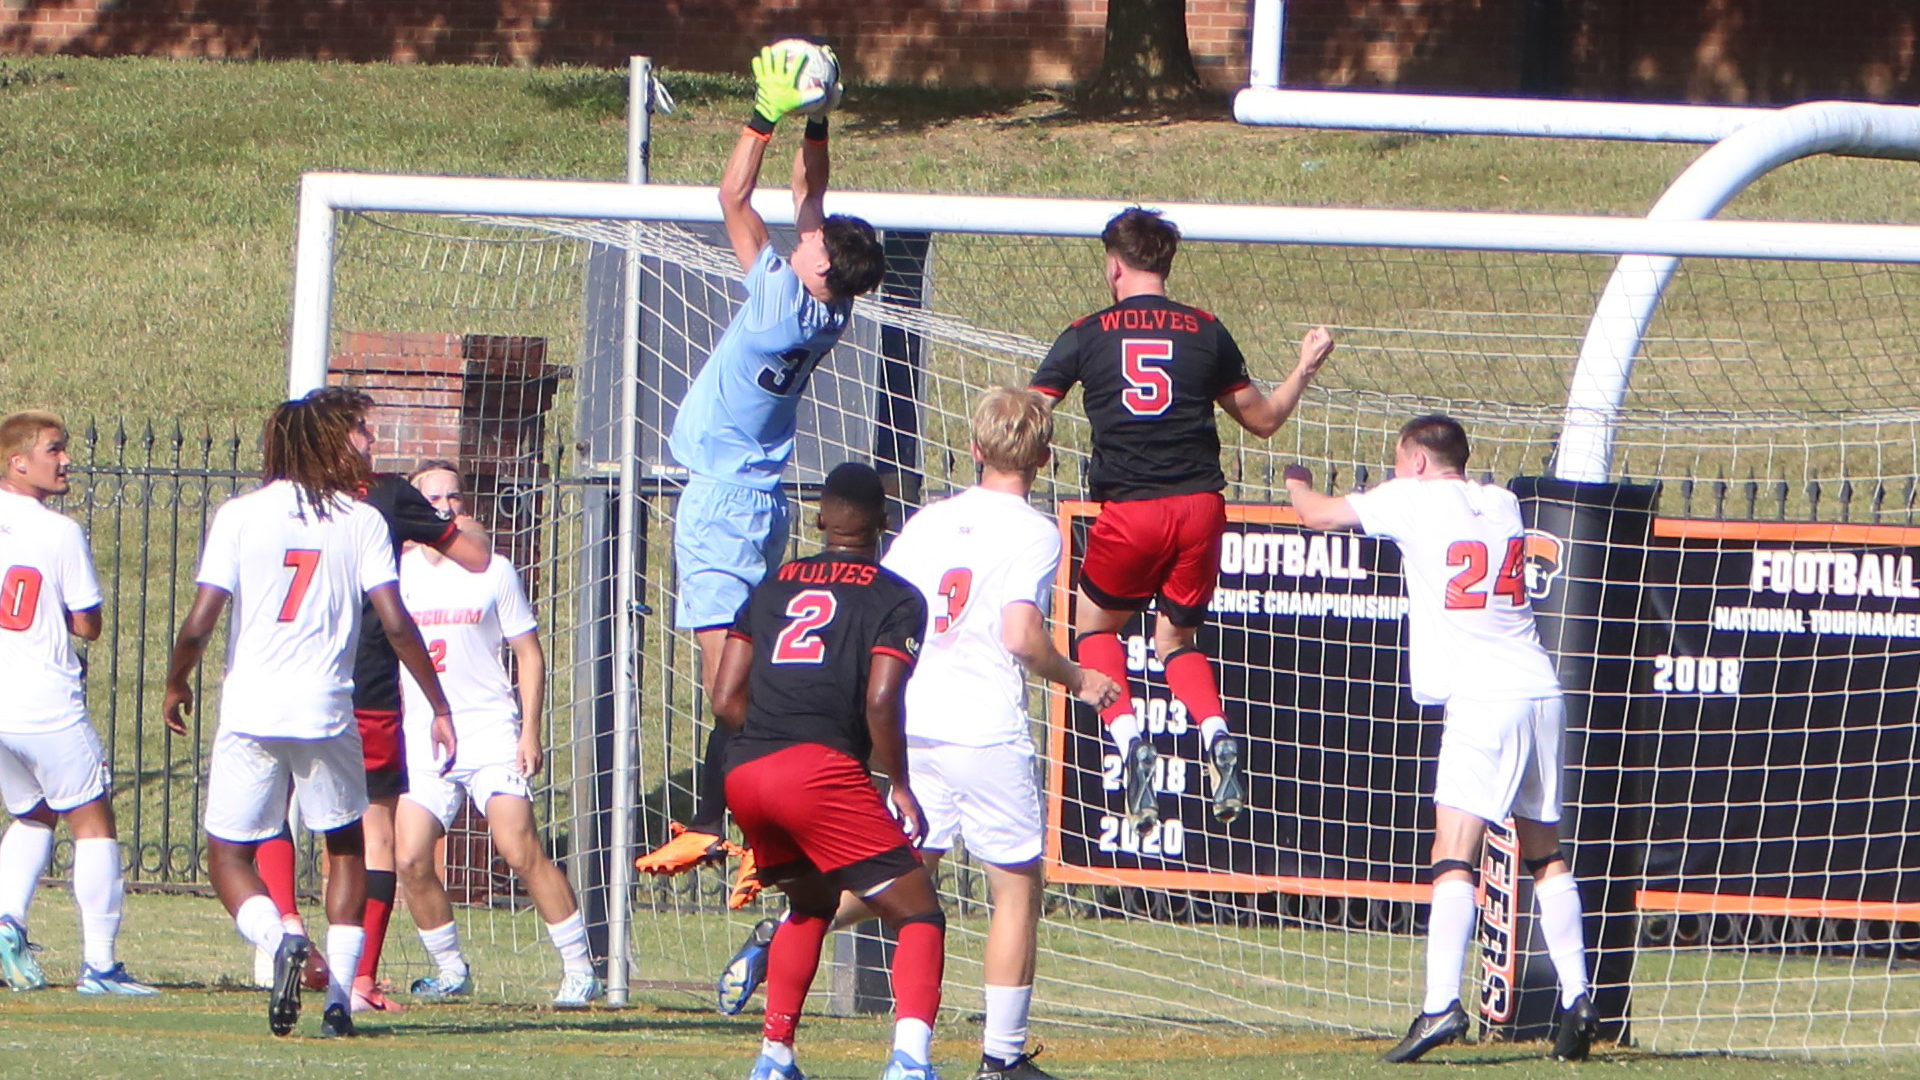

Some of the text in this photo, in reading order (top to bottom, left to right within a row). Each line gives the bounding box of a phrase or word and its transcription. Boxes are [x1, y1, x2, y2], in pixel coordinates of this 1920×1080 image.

[1100, 309, 1199, 332] WOLVES
[1122, 338, 1173, 416] 5
[778, 561, 878, 585] WOLVES
[1220, 531, 1368, 580] OOTBALL
[1445, 537, 1525, 609] 24
[1752, 550, 1920, 598] FOOTBALL
[277, 548, 321, 622] 7
[935, 566, 972, 634] 3
[1208, 588, 1260, 614] ENCE
[410, 607, 483, 626] SCULUM
[771, 589, 837, 664] 2
[1715, 606, 1920, 638] NATIONAL TOURNAME
[428, 638, 447, 673] 2
[1653, 654, 1739, 694] 2008
[1130, 697, 1188, 735] 003
